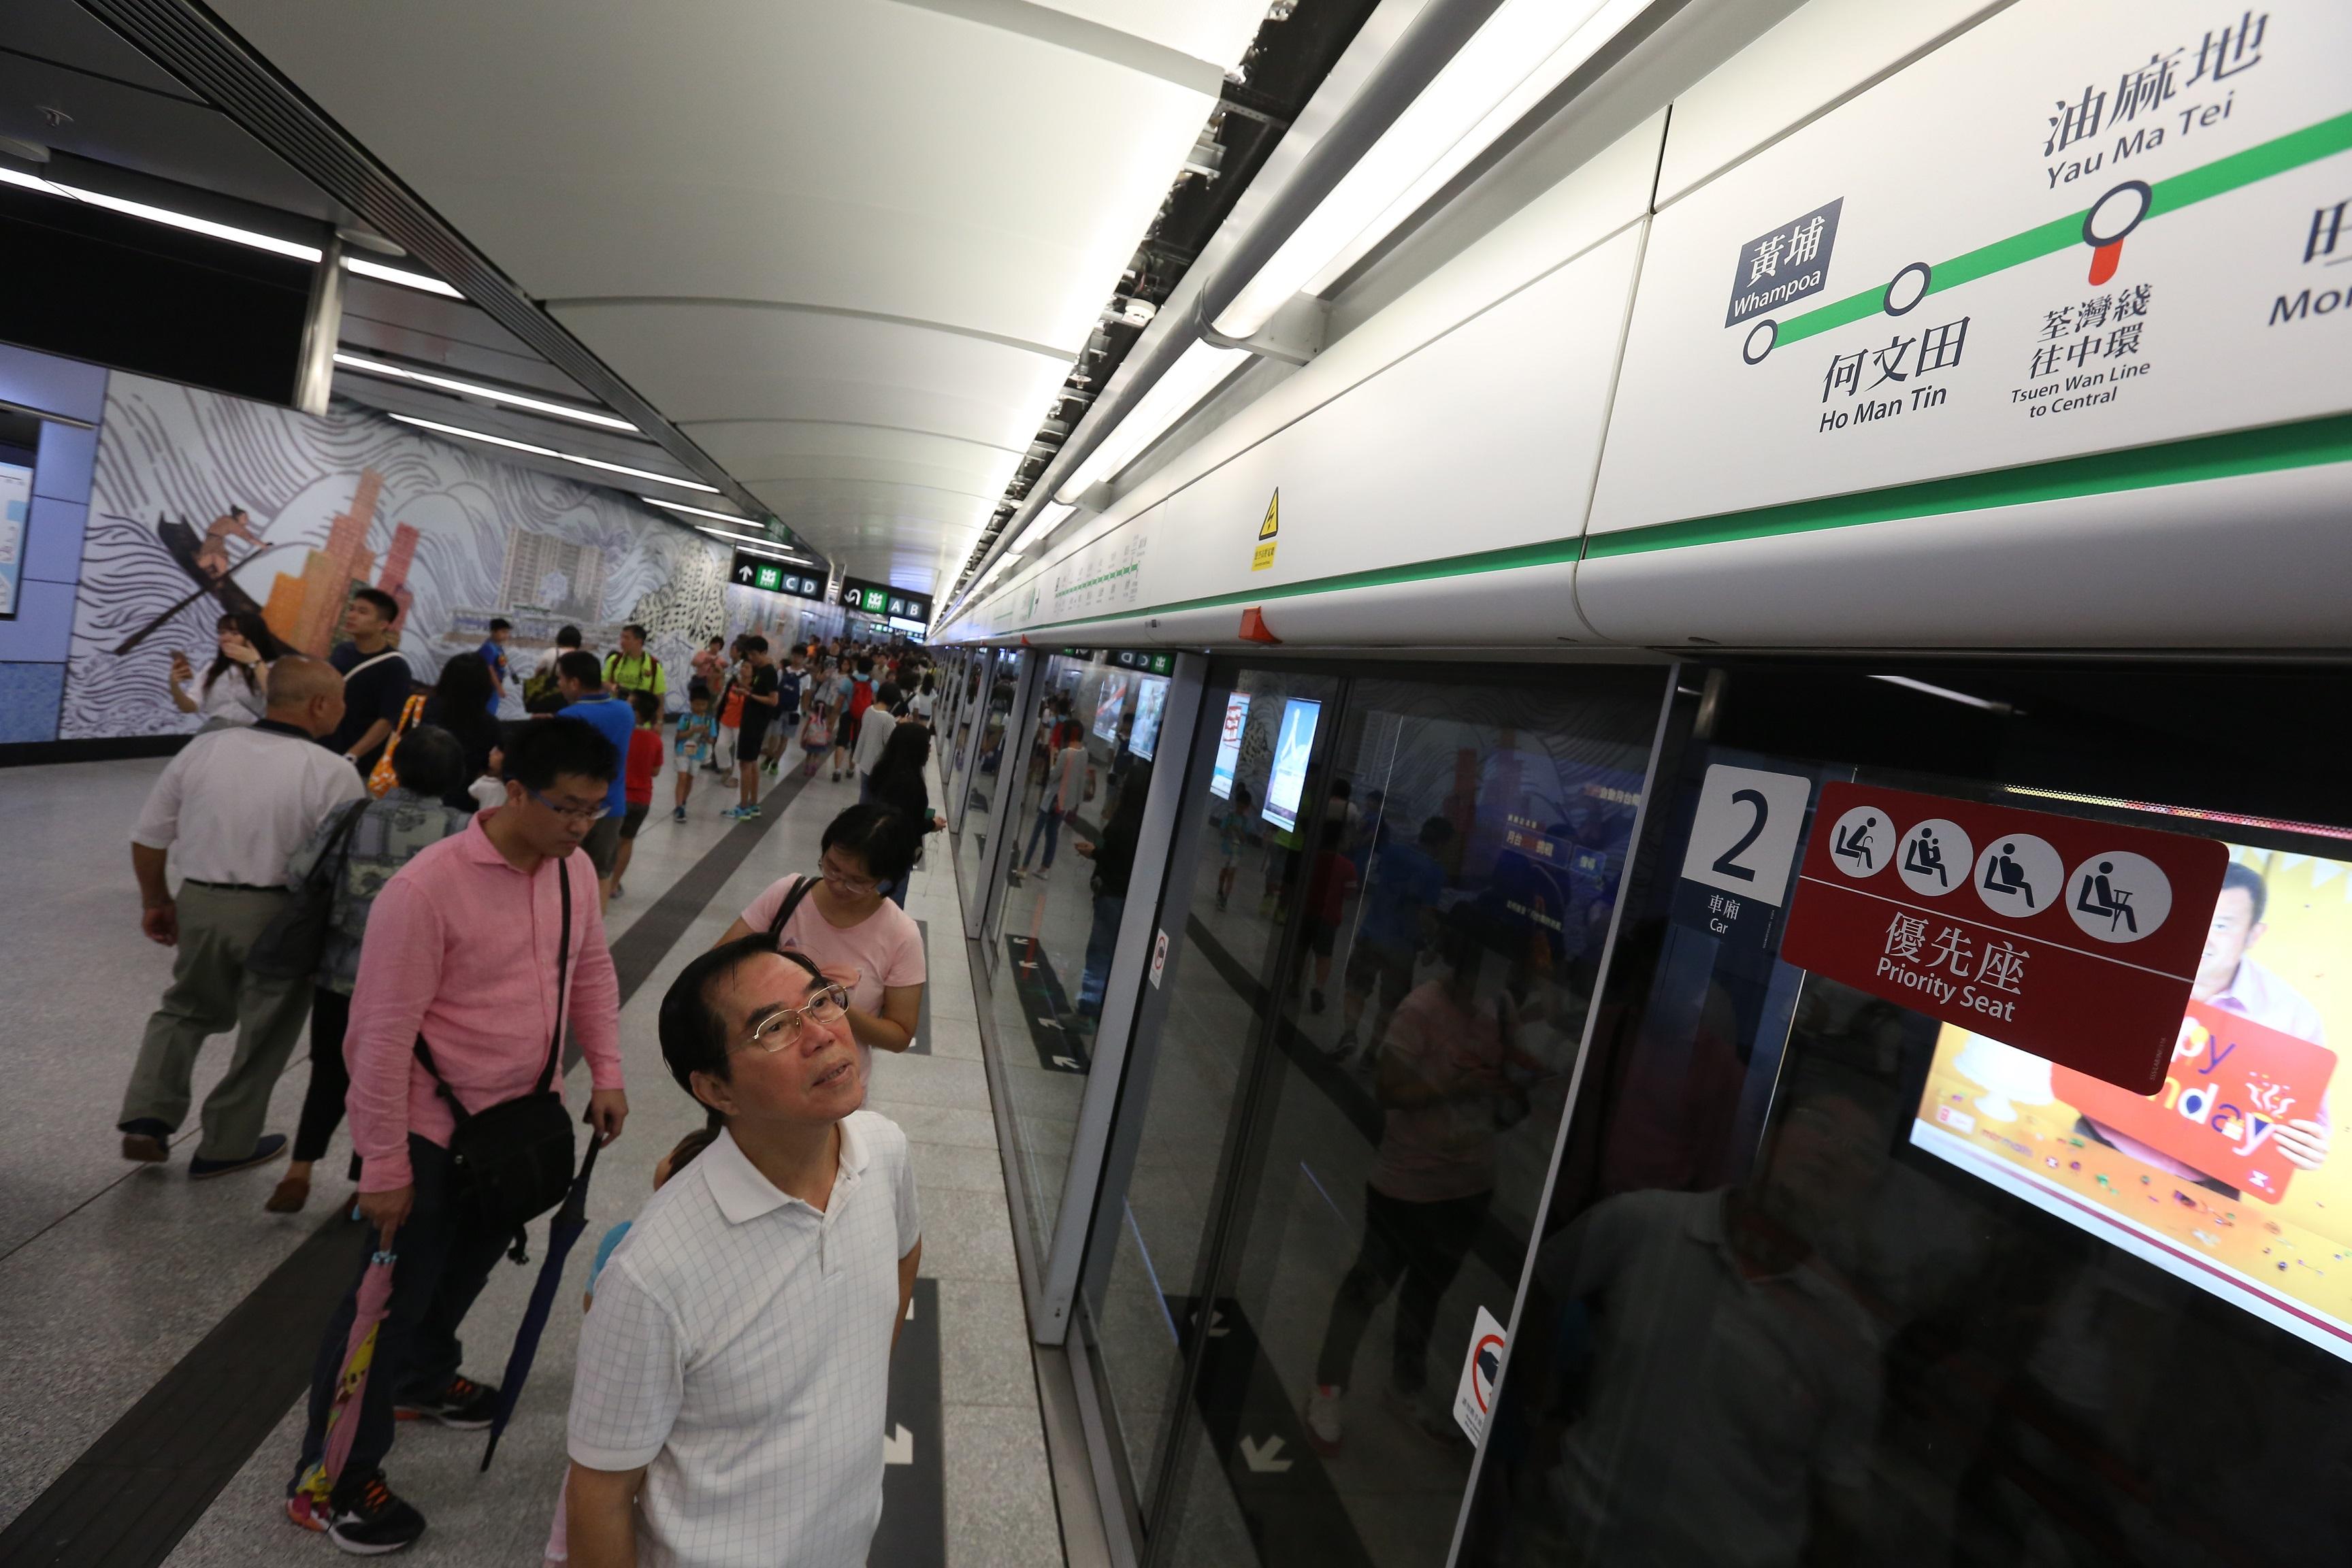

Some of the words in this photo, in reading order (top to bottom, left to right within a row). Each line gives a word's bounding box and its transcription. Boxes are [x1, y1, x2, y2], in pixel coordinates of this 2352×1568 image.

[2044, 10, 2270, 158] 油麻地
[2048, 154, 2103, 190] Yau
[2112, 128, 2165, 165] Ma
[2179, 91, 2234, 137] Tei
[1746, 216, 1825, 289] 黃埔
[1734, 270, 1821, 316] Whampoa
[2038, 284, 2152, 343] 荃灣綫
[2268, 286, 2352, 327] Mo
[1822, 316, 1971, 404] 何文田
[2029, 323, 2144, 380] 往中環
[1819, 409, 1849, 434] Ho
[1853, 398, 1902, 425] Man
[1911, 385, 1947, 411] Tin
[2012, 384, 2059, 404] Tsuen
[2066, 372, 2104, 392] Wan
[2109, 362, 2151, 382] Line
[2030, 404, 2047, 419] to
[2051, 386, 2117, 413] Central
[785, 578, 796, 589] C
[804, 582, 814, 593] D
[891, 601, 900, 612] A
[910, 604, 919, 615] B
[1712, 789, 1769, 883] 2
[1708, 894, 1740, 920] 車廂
[1710, 917, 1729, 935] Car
[1881, 911, 2030, 997] 優先座
[1876, 958, 1957, 1005] Priority
[1960, 985, 2016, 1022] Seat
